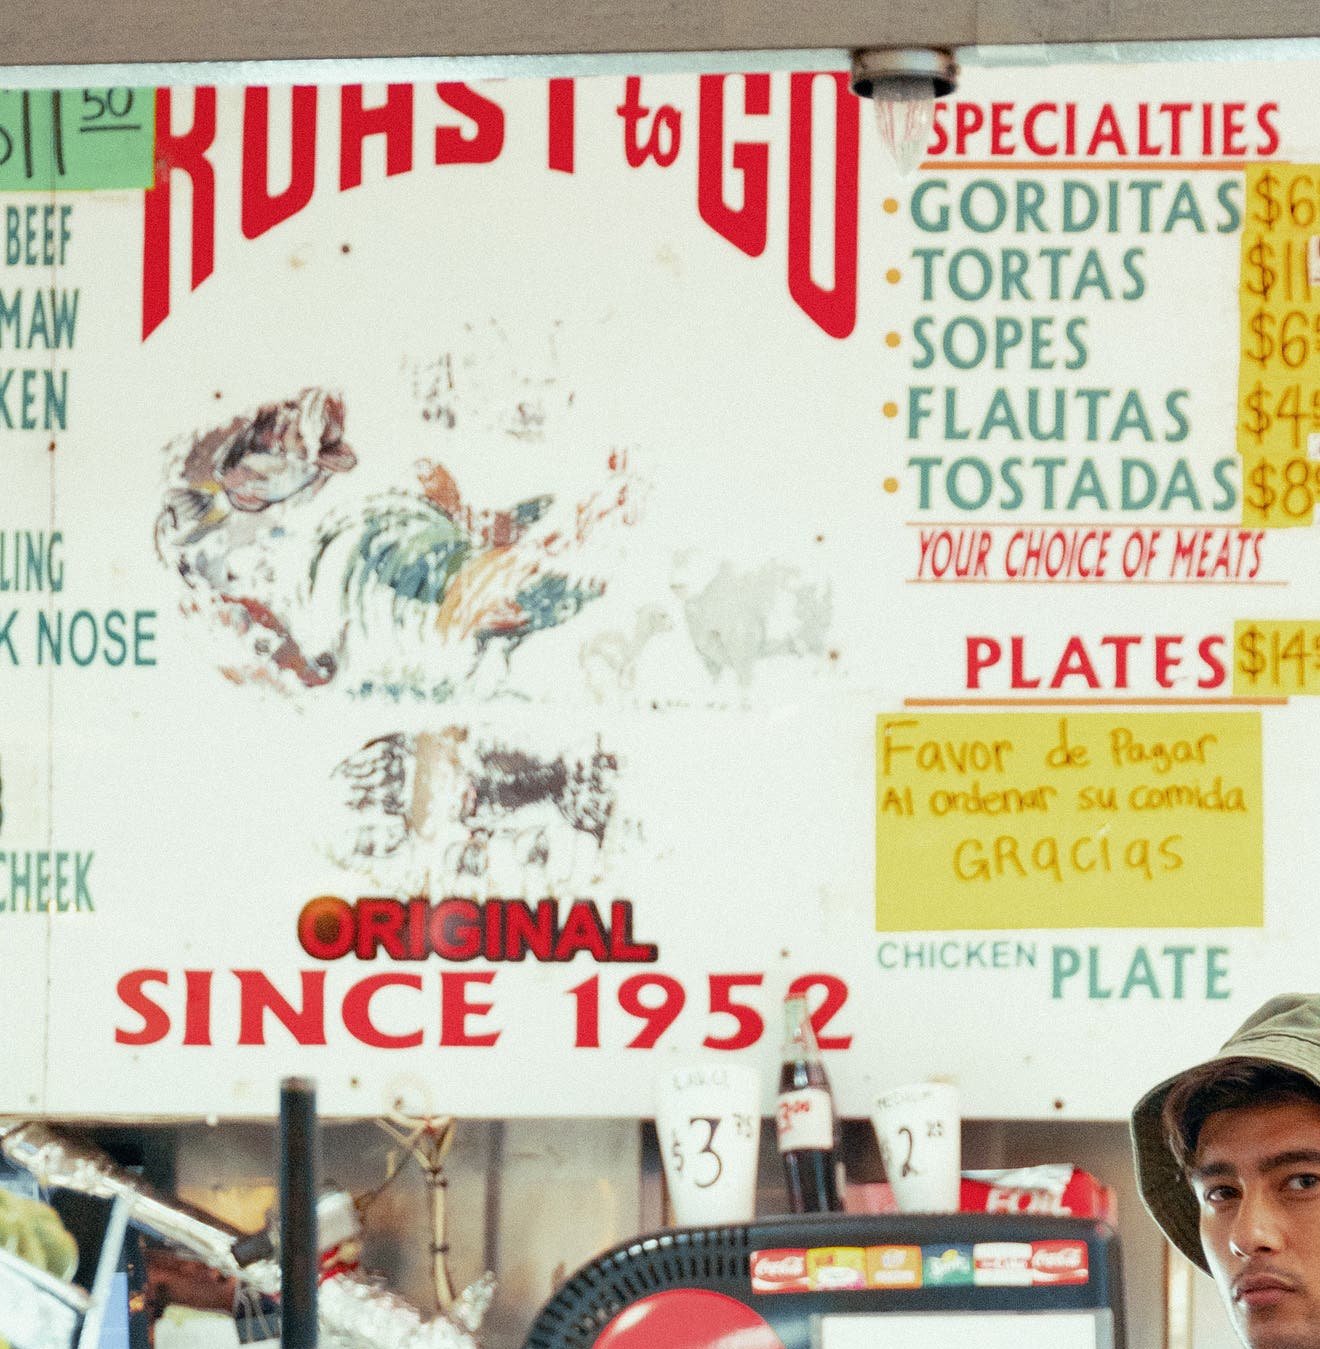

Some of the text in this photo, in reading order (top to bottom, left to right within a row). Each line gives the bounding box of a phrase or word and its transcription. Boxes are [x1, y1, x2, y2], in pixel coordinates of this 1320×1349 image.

[926, 101, 1282, 157] SPECIALTIES
[616, 76, 682, 168] to
[698, 72, 860, 340] GO
[910, 179, 1242, 235] GORDITAS
[6, 204, 73, 266] BEEF
[912, 247, 1148, 301] TORTAS
[0, 287, 80, 350] MAW
[912, 316, 1089, 371] SOPES
[906, 385, 1191, 442] FLAUTAS
[906, 456, 1239, 513] TOSTADAS
[917, 530, 1266, 580] YOUR CHOICE OF MEATS
[37, 609, 157, 667] NOSE
[965, 635, 1228, 690] PLATES
[882, 717, 1219, 776] Favor de Pagar
[929, 780, 1058, 817] ordenar
[1077, 785, 1119, 814] su
[1128, 776, 1249, 814] comida
[298, 896, 659, 963] ORIGINAL
[876, 940, 1233, 1001] CHICKEN PLATE
[114, 969, 854, 1050] SINCE 1952
